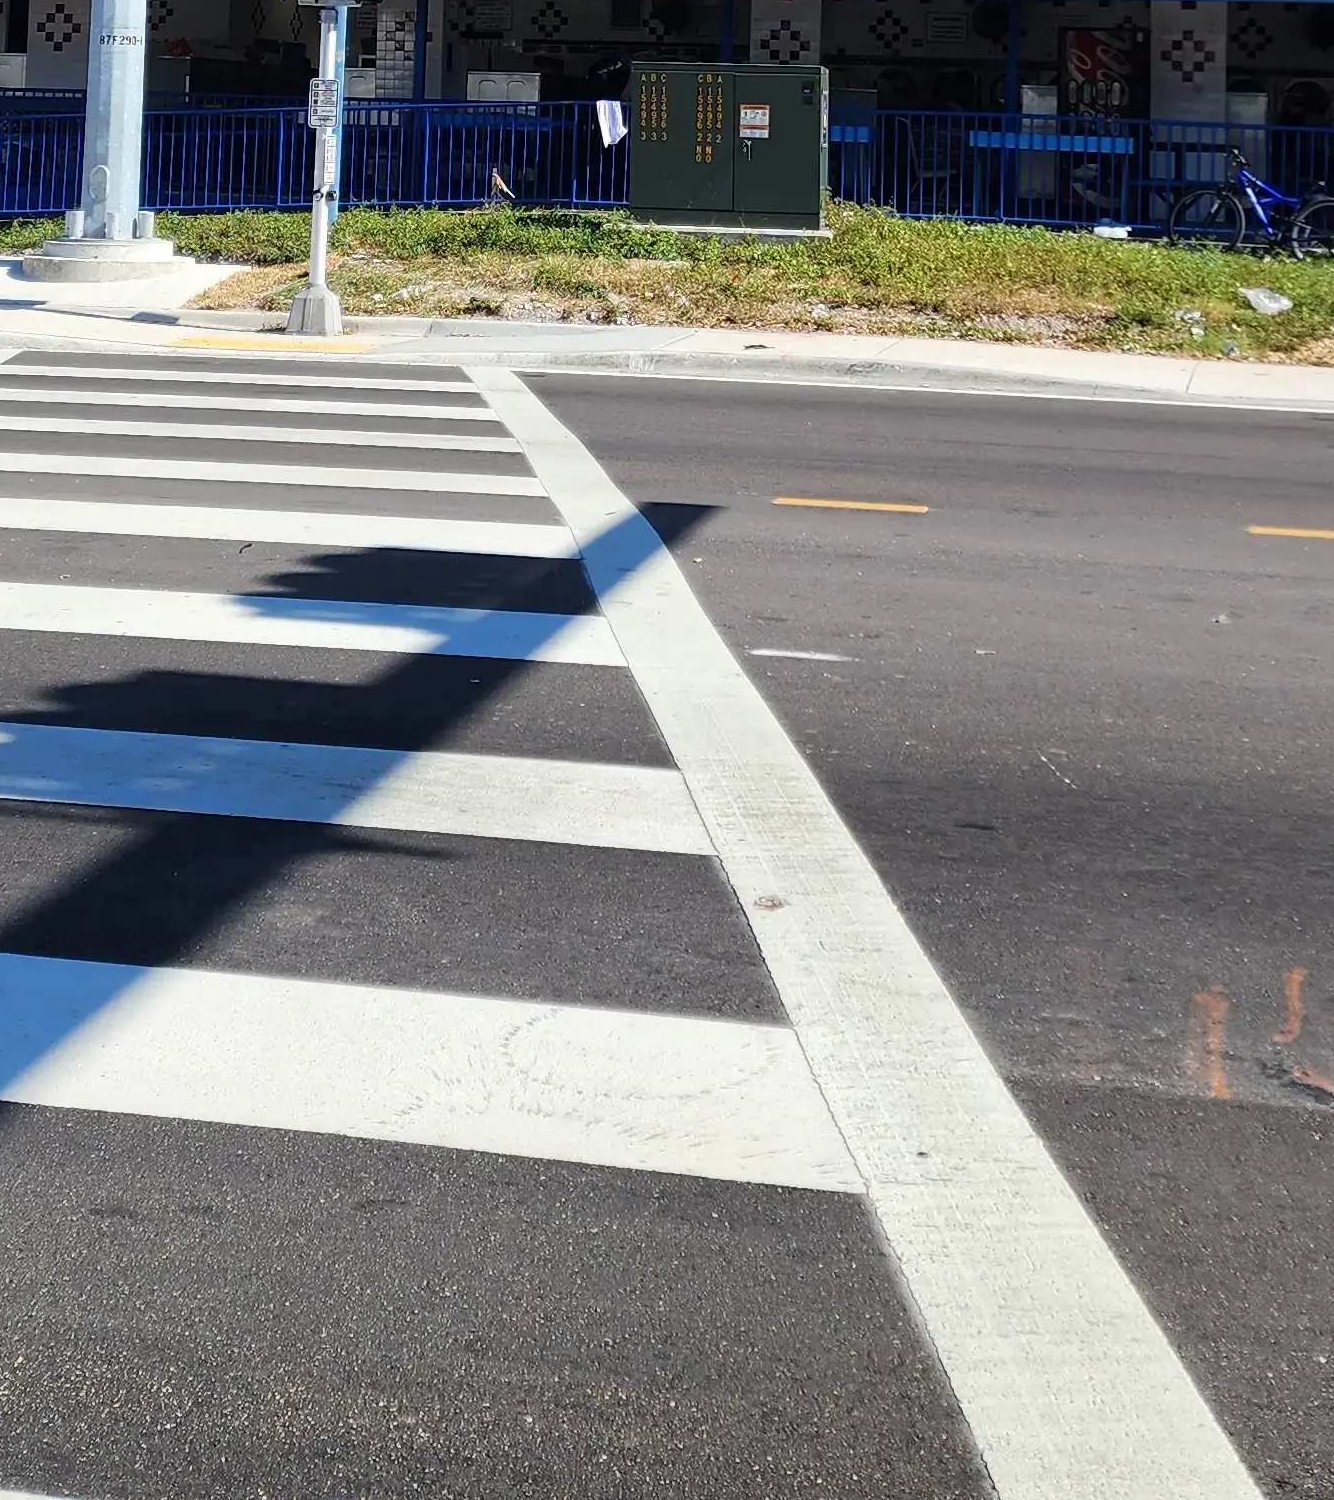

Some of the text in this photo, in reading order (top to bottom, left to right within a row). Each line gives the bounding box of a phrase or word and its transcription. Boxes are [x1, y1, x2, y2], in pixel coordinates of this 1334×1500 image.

[640, 73, 647, 82] A
[650, 73, 657, 82] B
[660, 73, 667, 83] C
[697, 73, 704, 83] C
[706, 74, 713, 83] B
[716, 75, 723, 84] A
